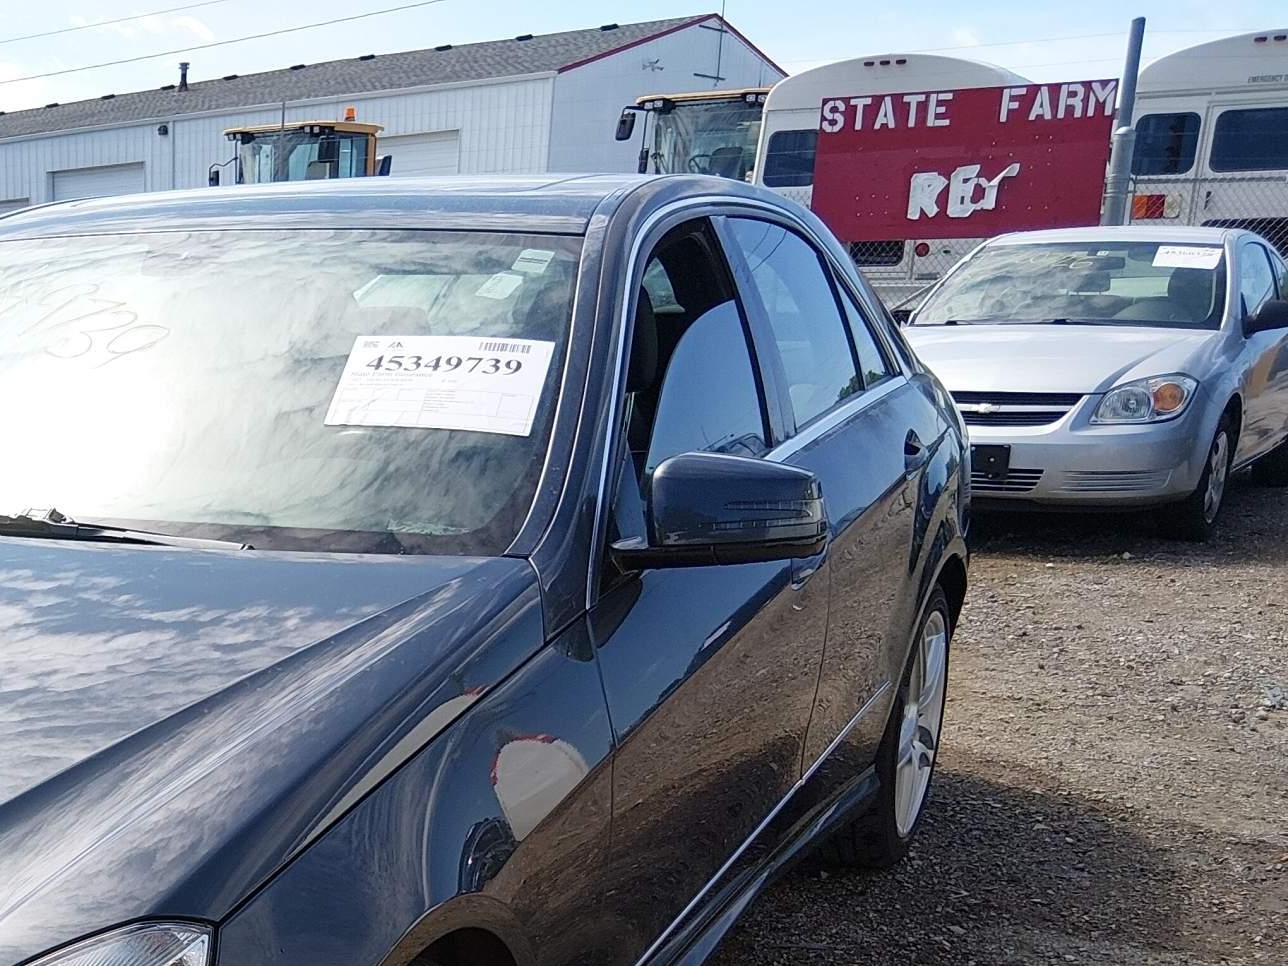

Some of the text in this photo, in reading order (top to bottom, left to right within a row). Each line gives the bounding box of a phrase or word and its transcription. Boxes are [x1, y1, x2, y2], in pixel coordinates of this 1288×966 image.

[821, 80, 1118, 133] STATE FARM
[365, 355, 523, 377] 45349739
